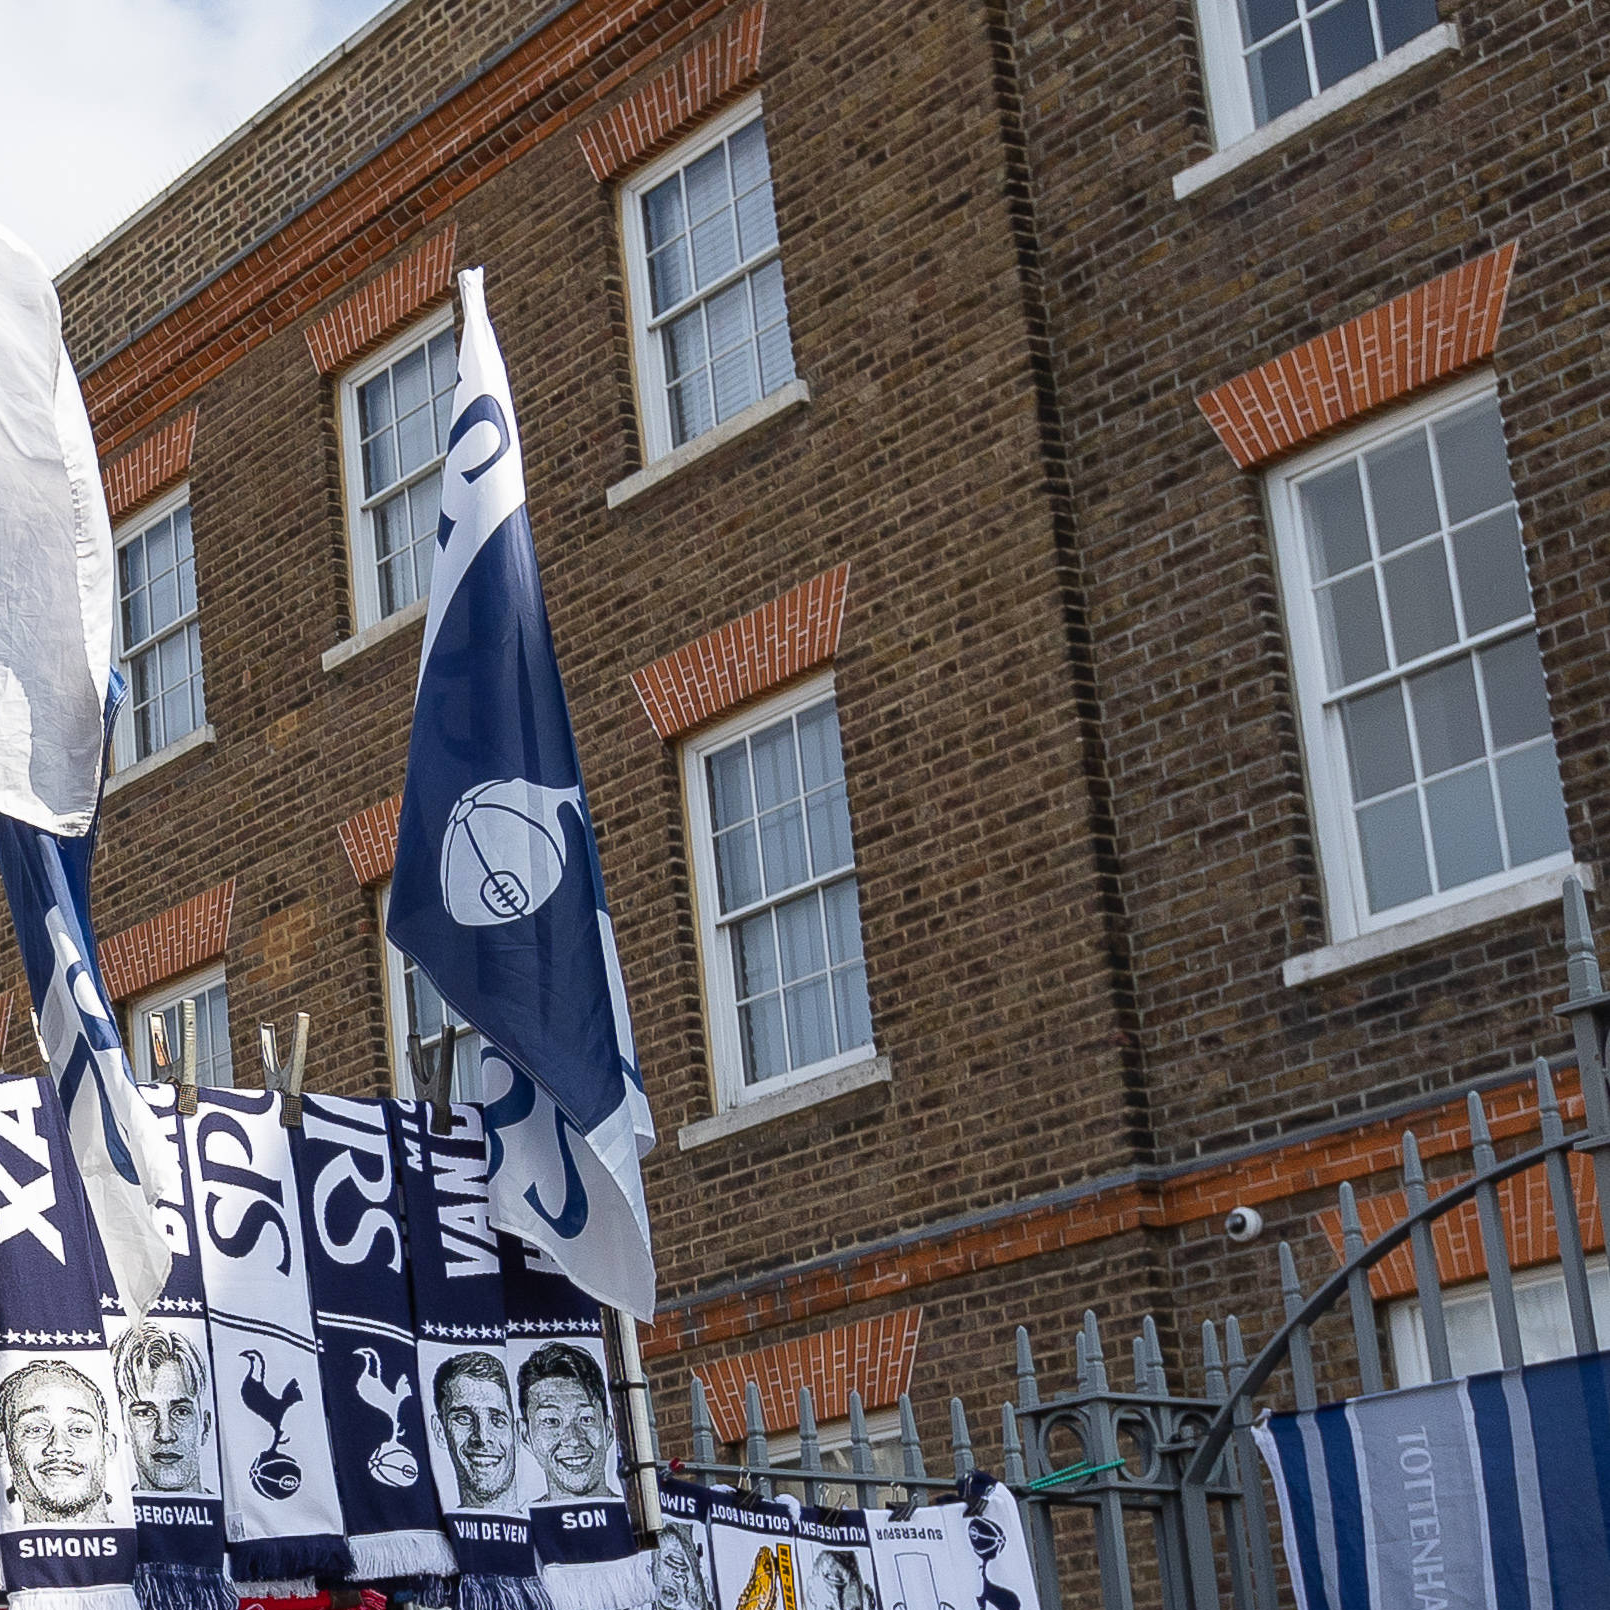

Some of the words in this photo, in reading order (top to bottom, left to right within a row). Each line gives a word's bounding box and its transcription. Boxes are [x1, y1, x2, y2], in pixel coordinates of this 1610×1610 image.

[132, 1504, 214, 1527] BERGVALL
[560, 1508, 608, 1530] SON
[453, 1518, 480, 1541] VAN
[482, 1522, 502, 1542] DE
[503, 1523, 528, 1546] VEN
[17, 1535, 119, 1561] SIMONS
